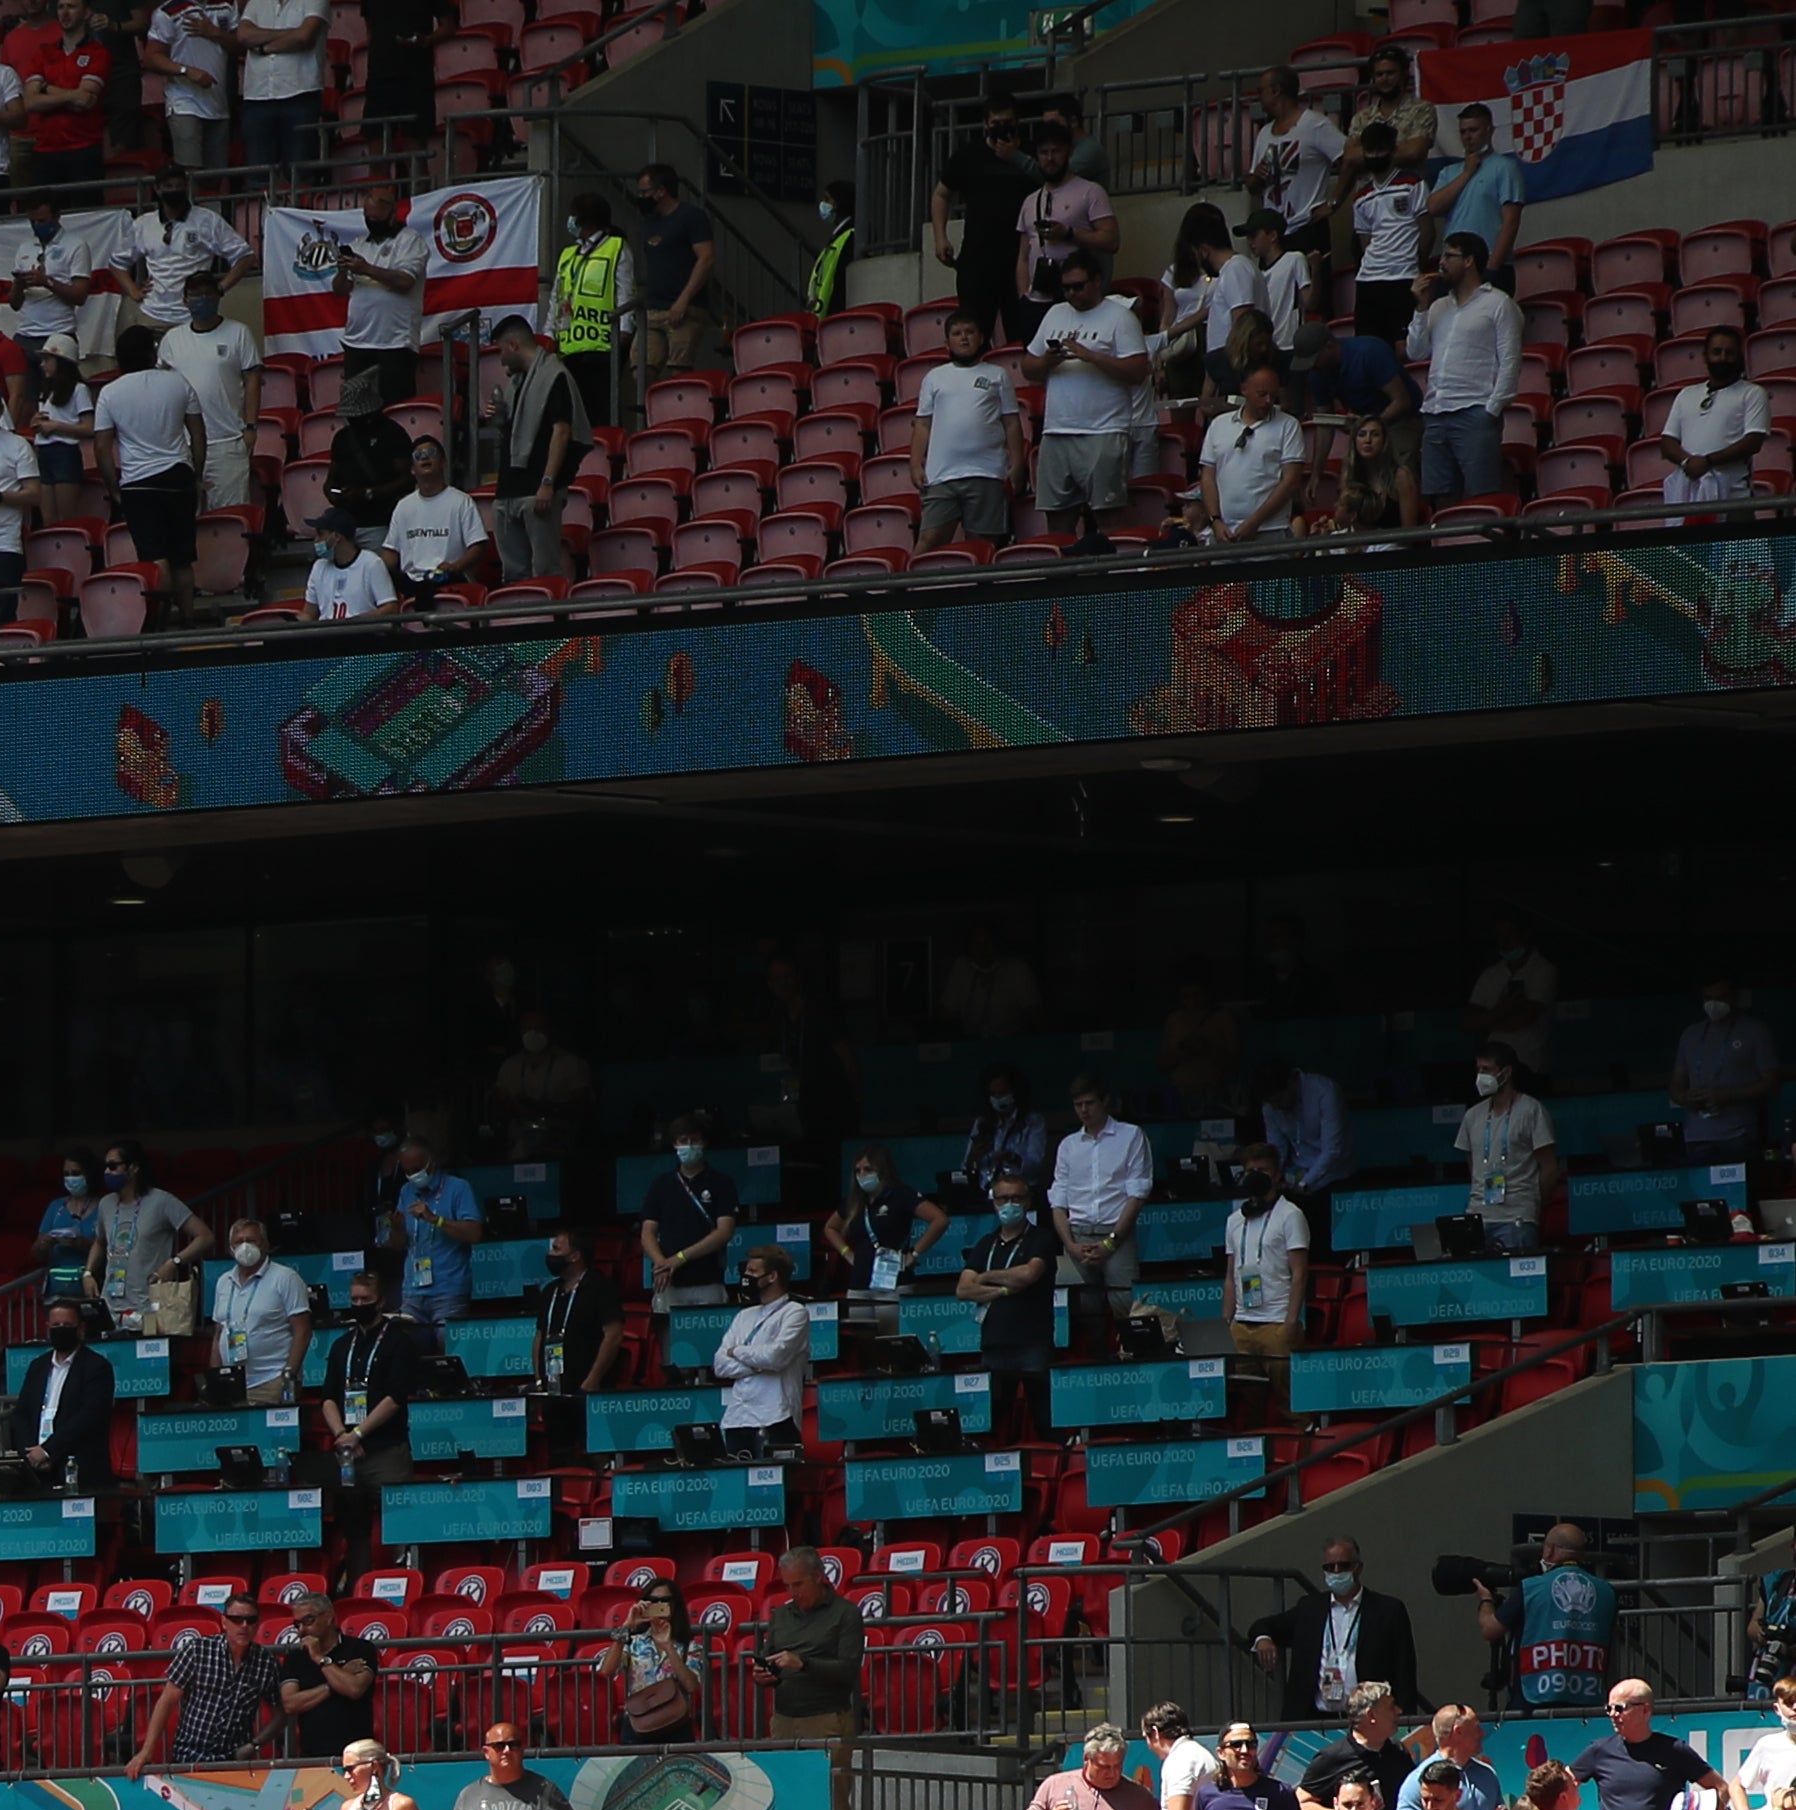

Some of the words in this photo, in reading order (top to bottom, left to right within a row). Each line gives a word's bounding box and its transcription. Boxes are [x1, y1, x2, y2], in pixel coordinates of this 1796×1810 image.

[1612, 1258, 1647, 1273] UEFA
[1650, 1257, 1685, 1270] EURO
[1688, 1255, 1721, 1269] 2020
[1403, 1273, 1437, 1286] EURO
[1441, 1269, 1473, 1283] 2020
[1171, 1288, 1203, 1301] EURO
[901, 1305, 930, 1317] UEFA
[933, 1303, 965, 1315] EURO
[1428, 1305, 1460, 1318] UEFA
[675, 1318, 705, 1329] UEFA
[450, 1328, 480, 1340] UEFA
[482, 1326, 514, 1339] EURO
[1329, 1358, 1362, 1370] EURO
[1365, 1356, 1396, 1369] 2020
[134, 1378, 162, 1391] 2020
[1088, 1373, 1121, 1386] EURO
[1124, 1371, 1154, 1384] 2020
[894, 1385, 925, 1397] 2020
[592, 1402, 621, 1414] UEFA
[625, 1400, 657, 1412] EURO
[660, 1398, 691, 1410] 2020
[1111, 1405, 1142, 1418] UEFA
[435, 1409, 464, 1421] 2020
[142, 1424, 172, 1435] UEFA
[174, 1421, 206, 1433] EURO
[209, 1418, 237, 1431] 2020
[883, 1419, 915, 1432] UEFA
[1091, 1453, 1124, 1467] UEFA
[1126, 1452, 1160, 1465] EURO
[1163, 1449, 1196, 1462] 2020
[848, 1469, 881, 1481] UEFA
[883, 1467, 916, 1480] EURO
[919, 1465, 950, 1477] 2020
[617, 1482, 648, 1495] UEFA
[651, 1480, 683, 1492] EURO
[687, 1478, 718, 1491] 2020
[1151, 1485, 1184, 1498] UEFA
[386, 1493, 416, 1505] UEFA
[419, 1491, 452, 1503] EURO
[456, 1489, 486, 1501] 2020
[906, 1500, 938, 1513] UEFA
[941, 1498, 974, 1511] EURO
[977, 1495, 1009, 1508] 2020
[3, 1509, 32, 1521] 2020
[160, 1503, 190, 1516] UEFA
[192, 1501, 225, 1514] EURO
[228, 1500, 258, 1512] 2020
[676, 1513, 707, 1526] UEFA
[710, 1510, 743, 1523] EURO
[747, 1508, 778, 1521] 2020
[442, 1524, 473, 1536] UEFA
[475, 1522, 509, 1535] EURO
[512, 1520, 542, 1533] 2020
[215, 1534, 246, 1546] UEFA
[248, 1532, 280, 1544] EURO
[283, 1530, 313, 1543] 2020
[22, 1541, 54, 1553] EURO
[57, 1539, 87, 1551] 2020
